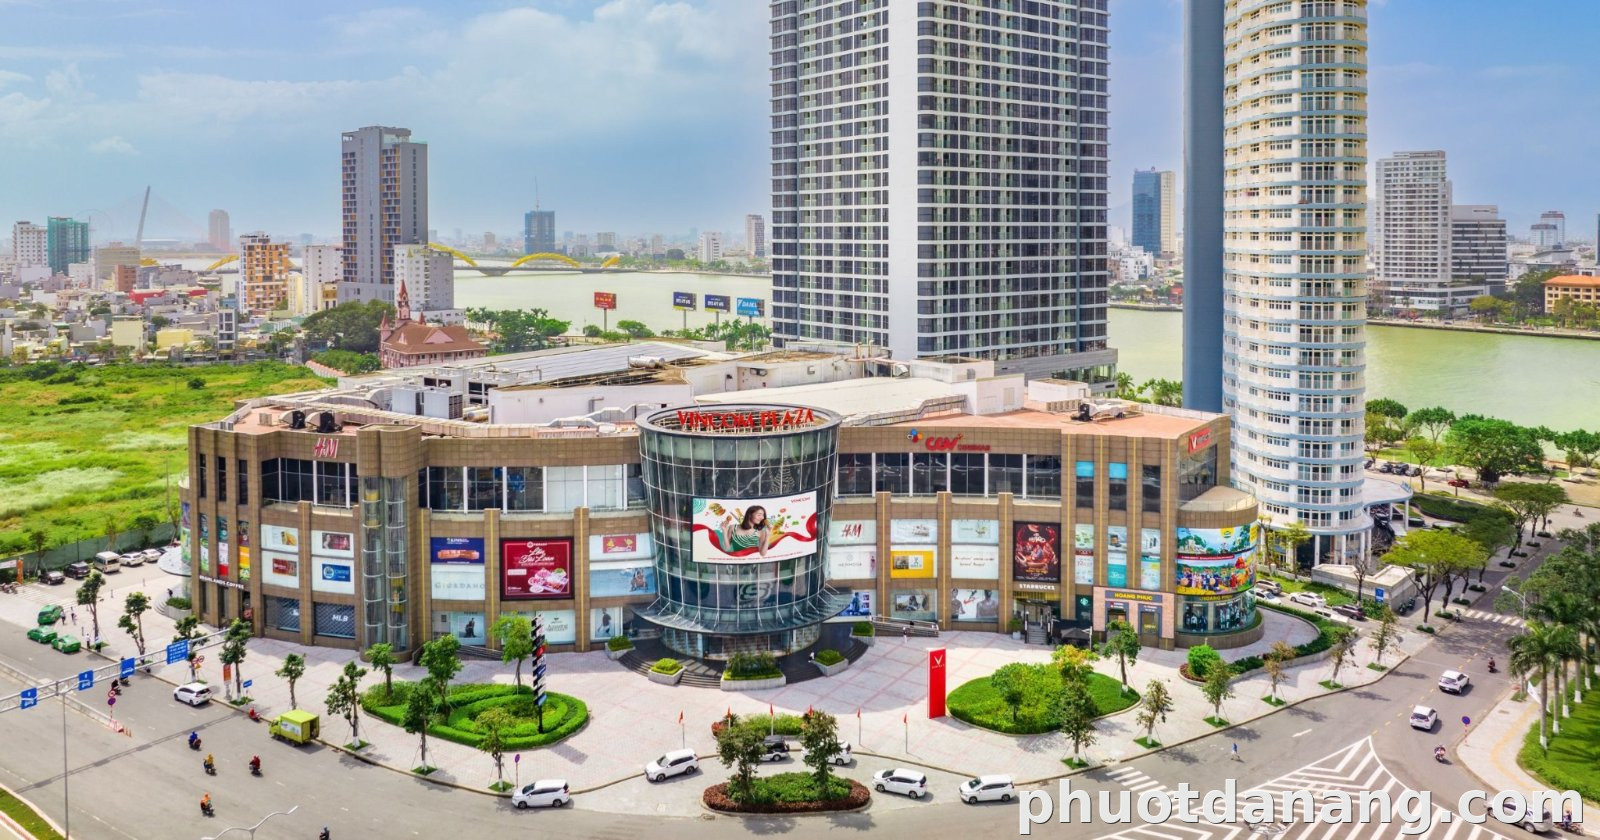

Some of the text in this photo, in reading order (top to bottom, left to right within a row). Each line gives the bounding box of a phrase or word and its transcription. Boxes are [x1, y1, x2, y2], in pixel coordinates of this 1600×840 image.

[677, 408, 815, 429] VINCOM PLAZA
[313, 437, 339, 459] H&M
[925, 434, 960, 451] CGV
[842, 523, 862, 538] H&M
[1019, 583, 1056, 591] STARBUCKS
[332, 614, 349, 622] MLB
